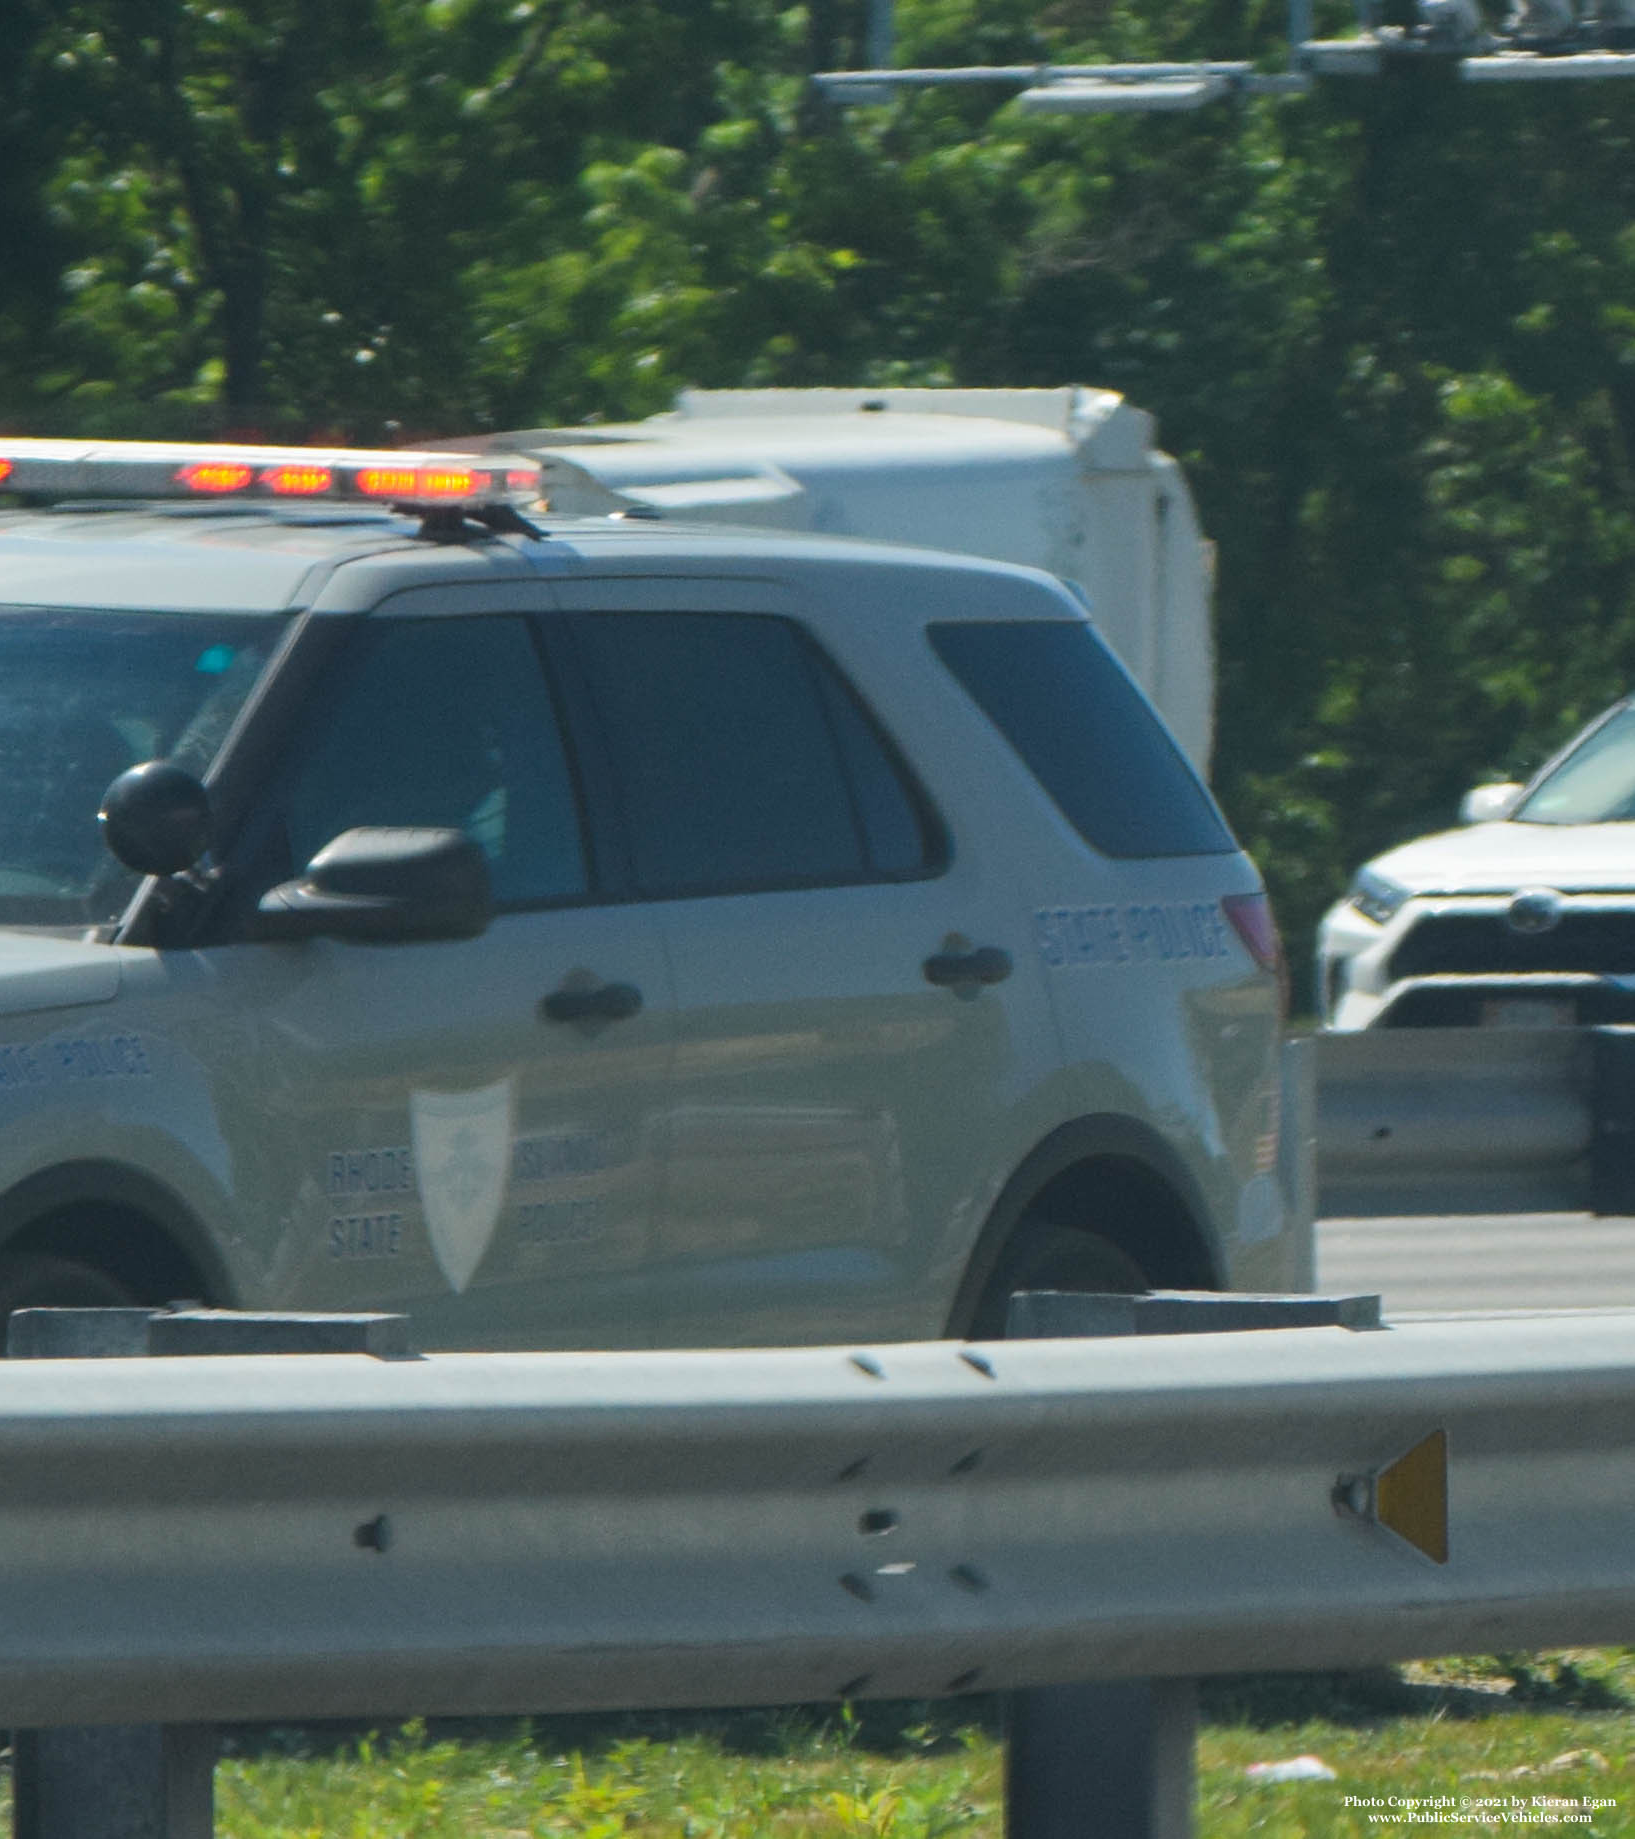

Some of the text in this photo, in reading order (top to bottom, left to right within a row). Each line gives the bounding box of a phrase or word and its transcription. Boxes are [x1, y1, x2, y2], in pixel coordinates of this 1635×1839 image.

[1035, 903, 1230, 966] STATE POLICE
[50, 1035, 153, 1079] POLICE
[328, 1149, 412, 1195] RHODE
[329, 1213, 401, 1258] STATE
